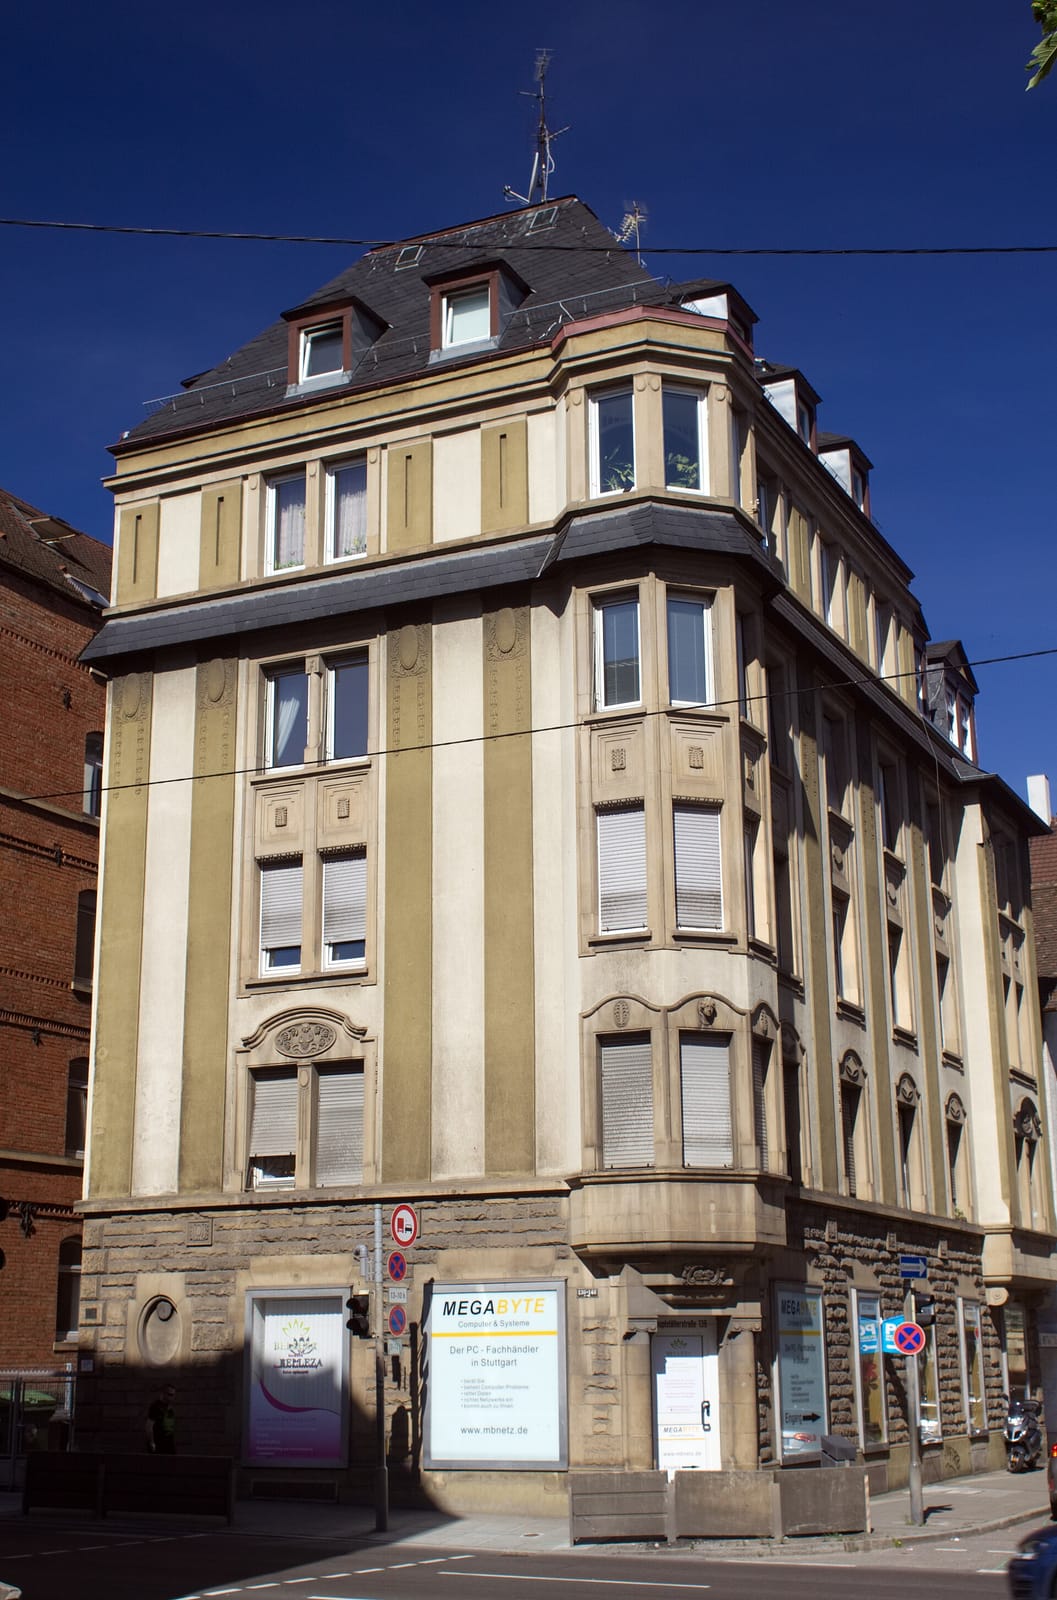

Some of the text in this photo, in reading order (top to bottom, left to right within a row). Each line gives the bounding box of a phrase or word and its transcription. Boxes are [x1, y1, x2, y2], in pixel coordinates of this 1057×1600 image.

[442, 1298, 545, 1316] MEGABYTE
[458, 1320, 493, 1329] Computer
[499, 1319, 530, 1328] Systeme
[450, 1346, 464, 1354] Der
[466, 1345, 479, 1354] PC
[486, 1345, 539, 1354] Fachhändler
[481, 1358, 517, 1368] Stuttgart
[461, 1426, 528, 1435] www.mbnetz.de
